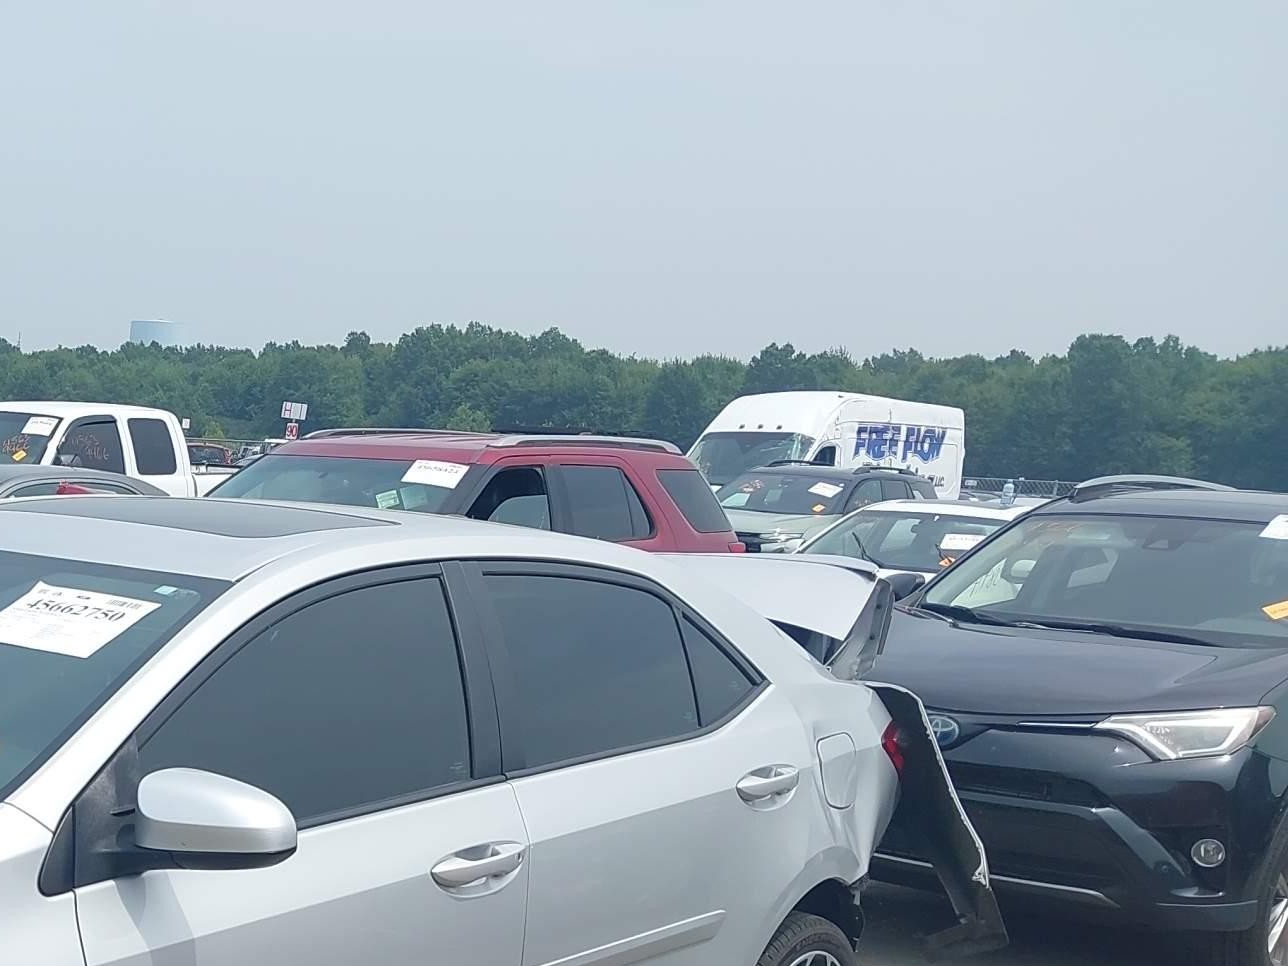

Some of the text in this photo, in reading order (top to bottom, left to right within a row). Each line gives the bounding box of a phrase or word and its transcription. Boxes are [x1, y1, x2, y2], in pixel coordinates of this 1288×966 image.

[284, 402, 292, 417] H
[286, 425, 297, 438] 90
[852, 424, 948, 464] FREE FLOW
[27, 598, 126, 622] 45662750
